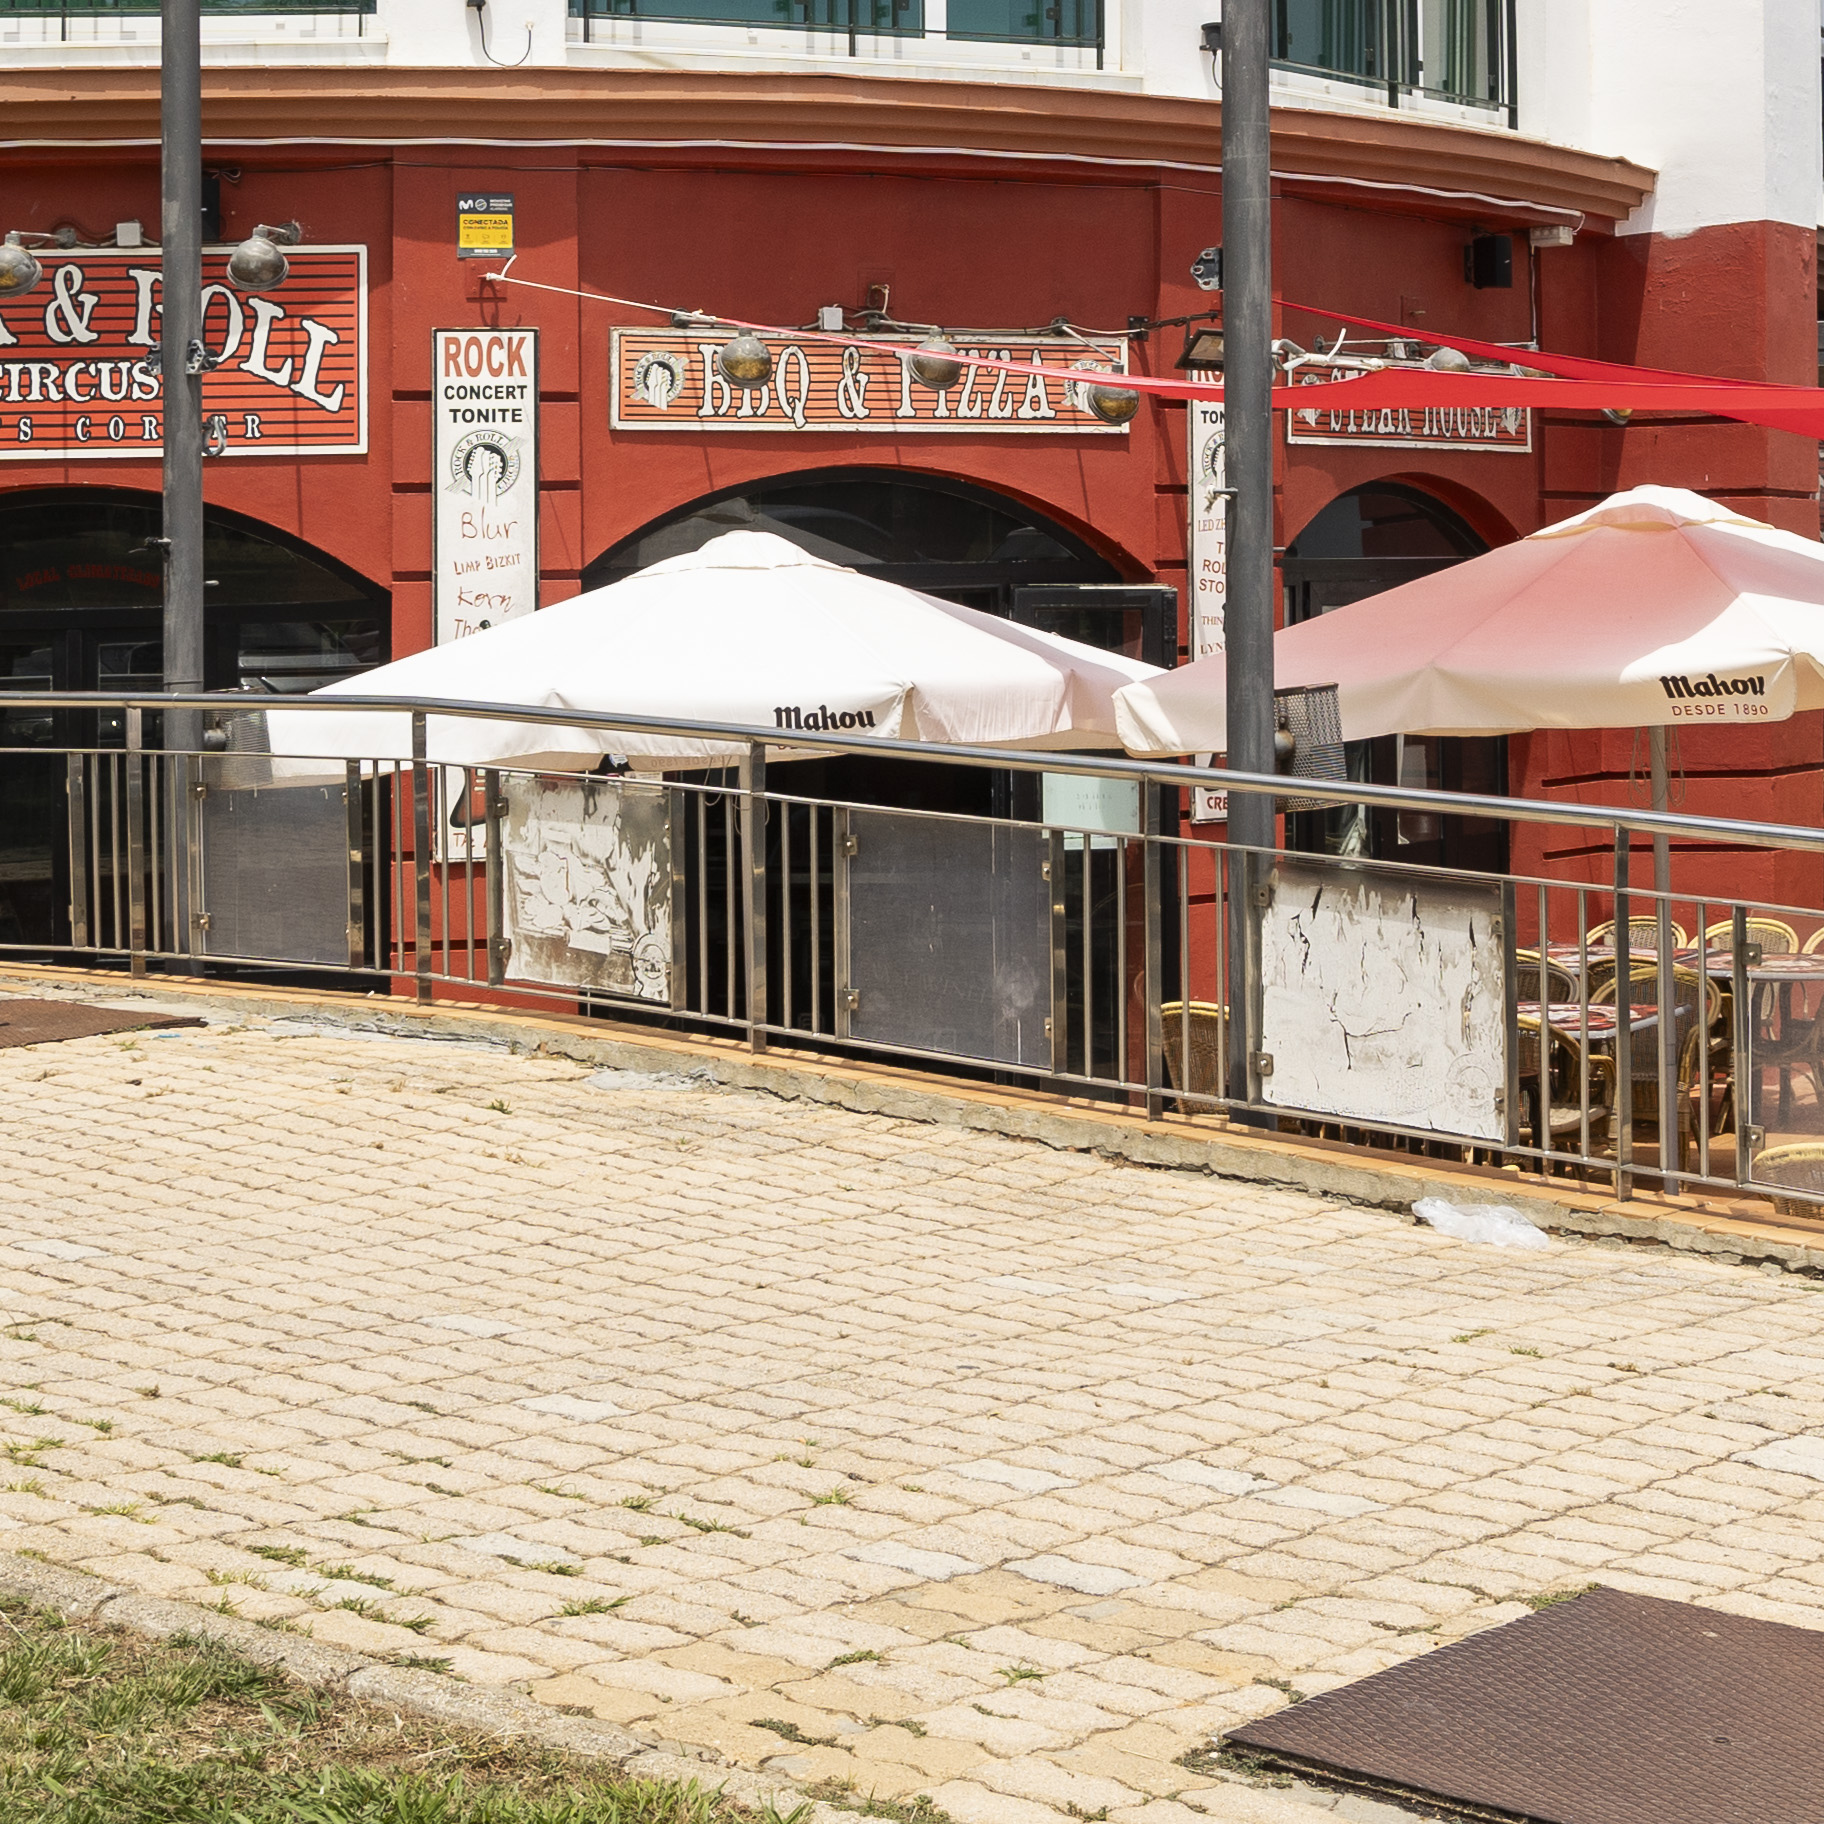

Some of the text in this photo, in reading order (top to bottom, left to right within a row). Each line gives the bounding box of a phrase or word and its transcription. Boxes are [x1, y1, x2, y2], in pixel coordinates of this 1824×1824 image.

[44, 264, 100, 344] &
[444, 336, 528, 377] ROCK
[444, 385, 528, 400] CONCERT
[837, 345, 870, 420] &
[75, 414, 262, 441] CORR
[448, 408, 523, 423] TONITE
[461, 505, 518, 540] Blur
[1198, 519, 1214, 532] LED
[454, 553, 521, 576] LIMP BIZKIT
[1659, 673, 1765, 699] Mahou
[773, 704, 876, 732] Mahou
[1671, 703, 1769, 717] DESDE 1890
